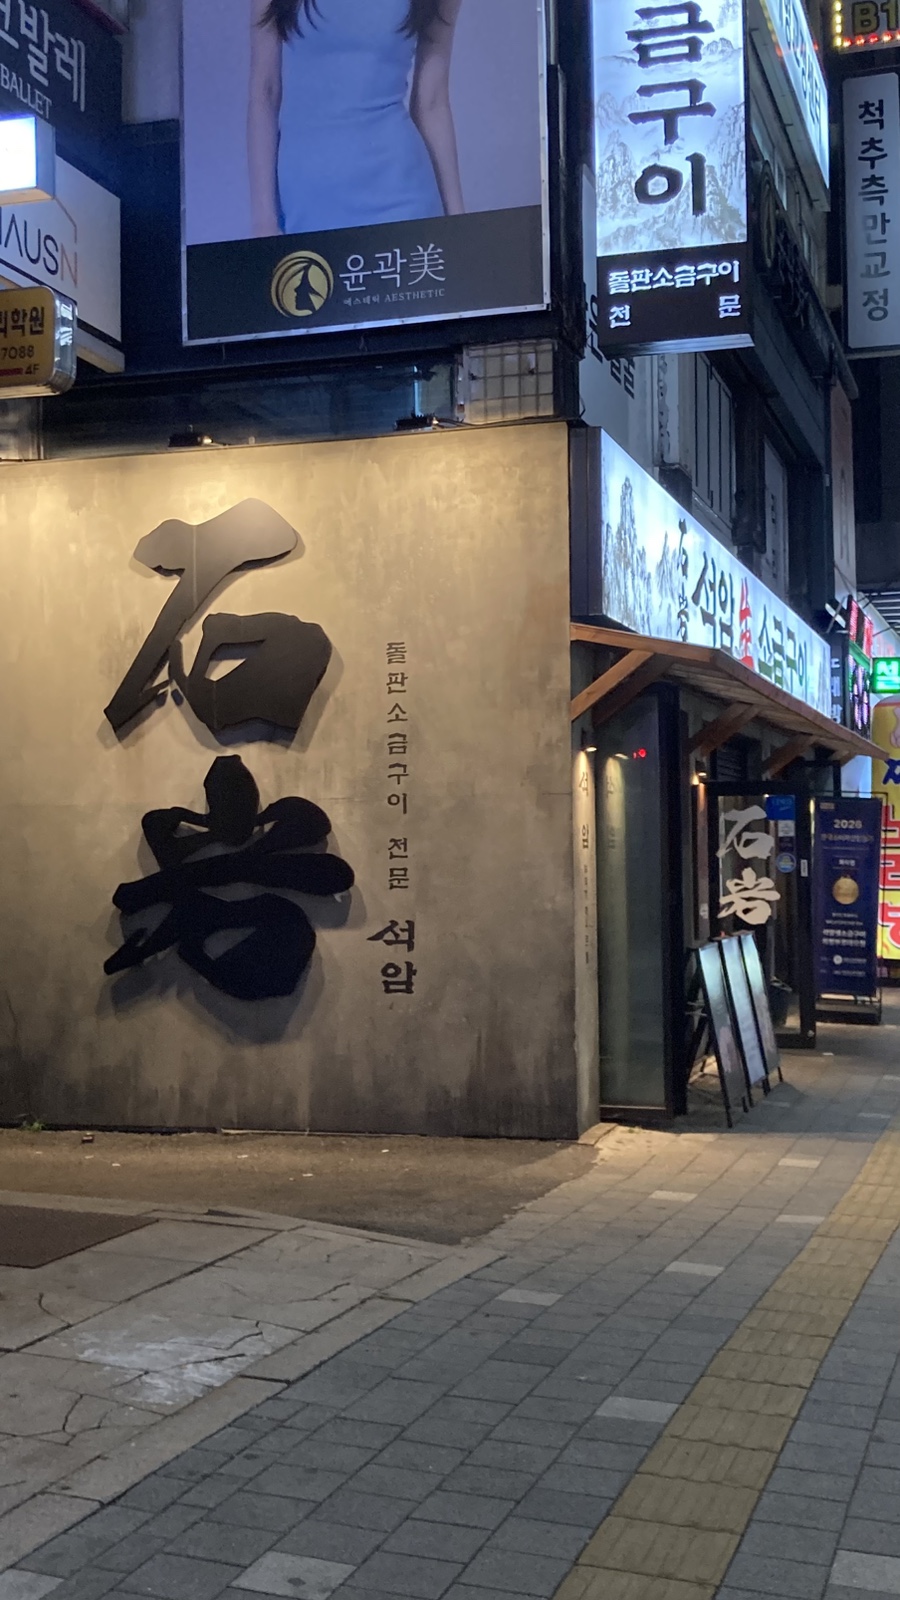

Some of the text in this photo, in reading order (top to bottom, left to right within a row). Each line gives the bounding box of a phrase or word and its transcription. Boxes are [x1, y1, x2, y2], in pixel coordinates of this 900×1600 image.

[0, 63, 52, 119] BALLET
[626, 0, 716, 218] 금구이
[857, 99, 893, 323] 척추측만교정
[0, 206, 77, 288] AUSN
[339, 243, 446, 292] 윤곽美
[384, 288, 445, 303] AESTHETIC
[608, 260, 740, 295] 돌판소금구이
[25, 363, 40, 375] 4F
[367, 641, 418, 995] 돌판소금구이 전문 석암
